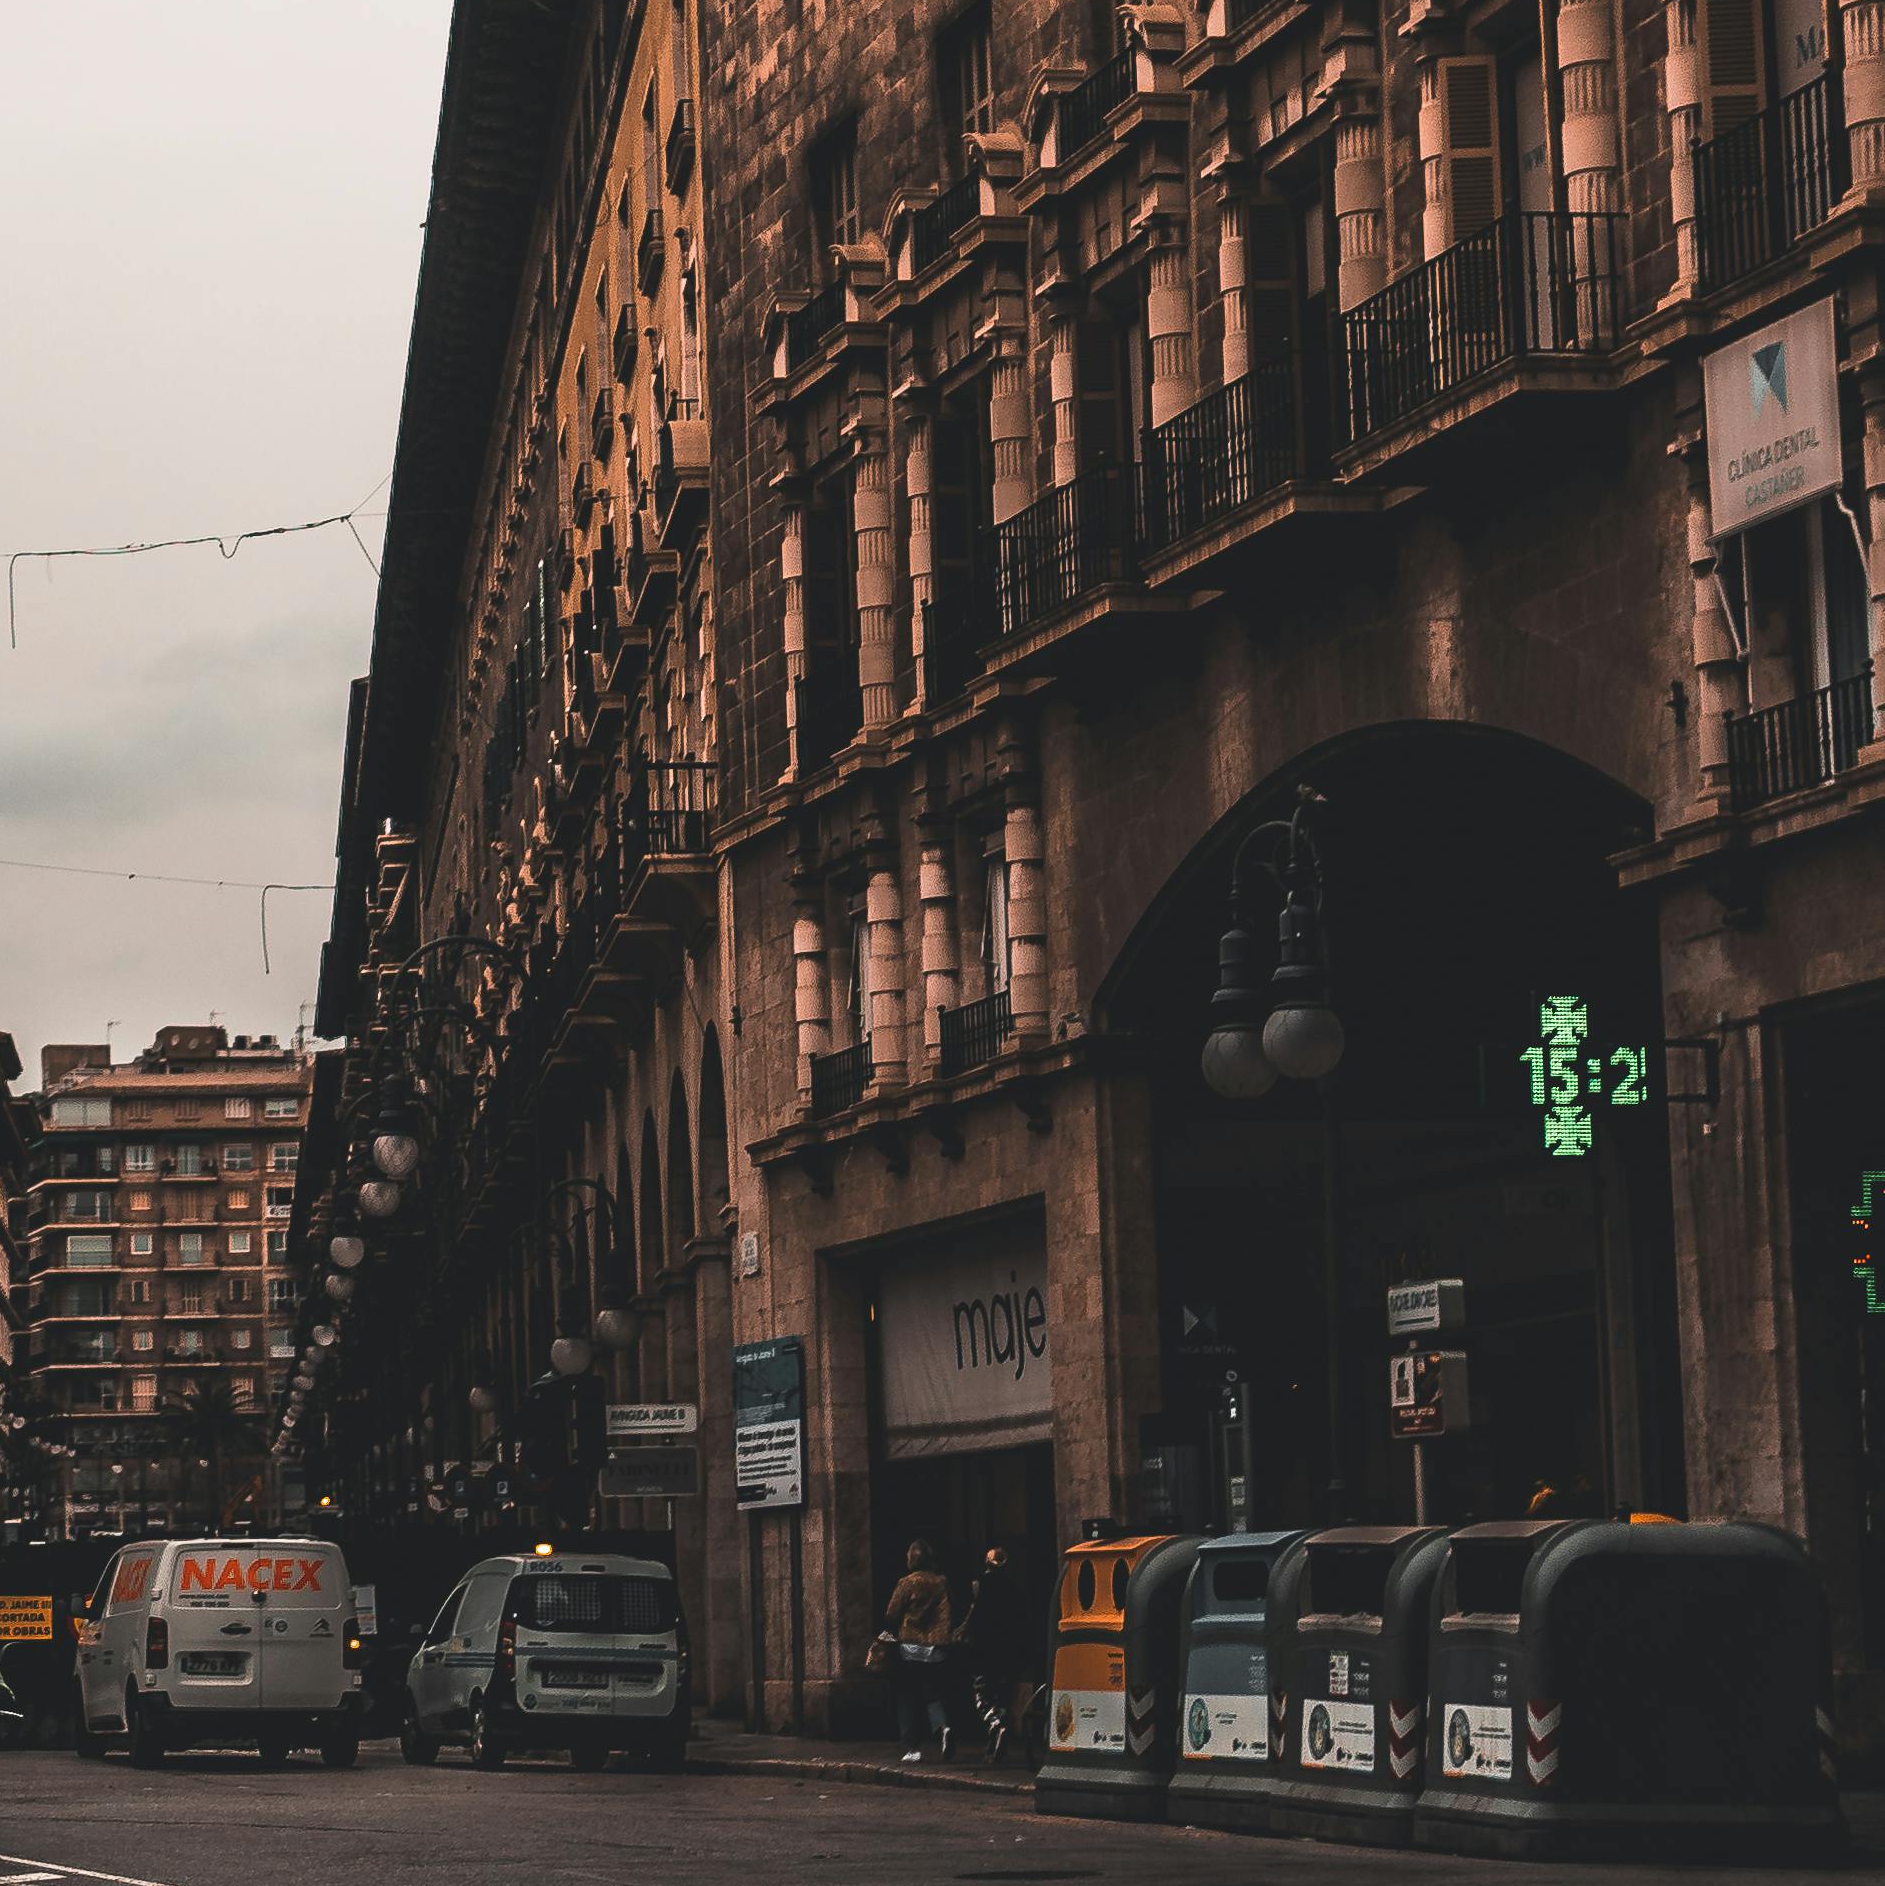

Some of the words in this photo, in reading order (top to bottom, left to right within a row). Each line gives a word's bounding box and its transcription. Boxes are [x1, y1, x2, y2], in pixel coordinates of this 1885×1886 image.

[1519, 1046, 1647, 1105] 15:2
[953, 1269, 1046, 1380] maje
[181, 1558, 325, 1591] NACEX
[12, 1626, 51, 1636] OBRAS
